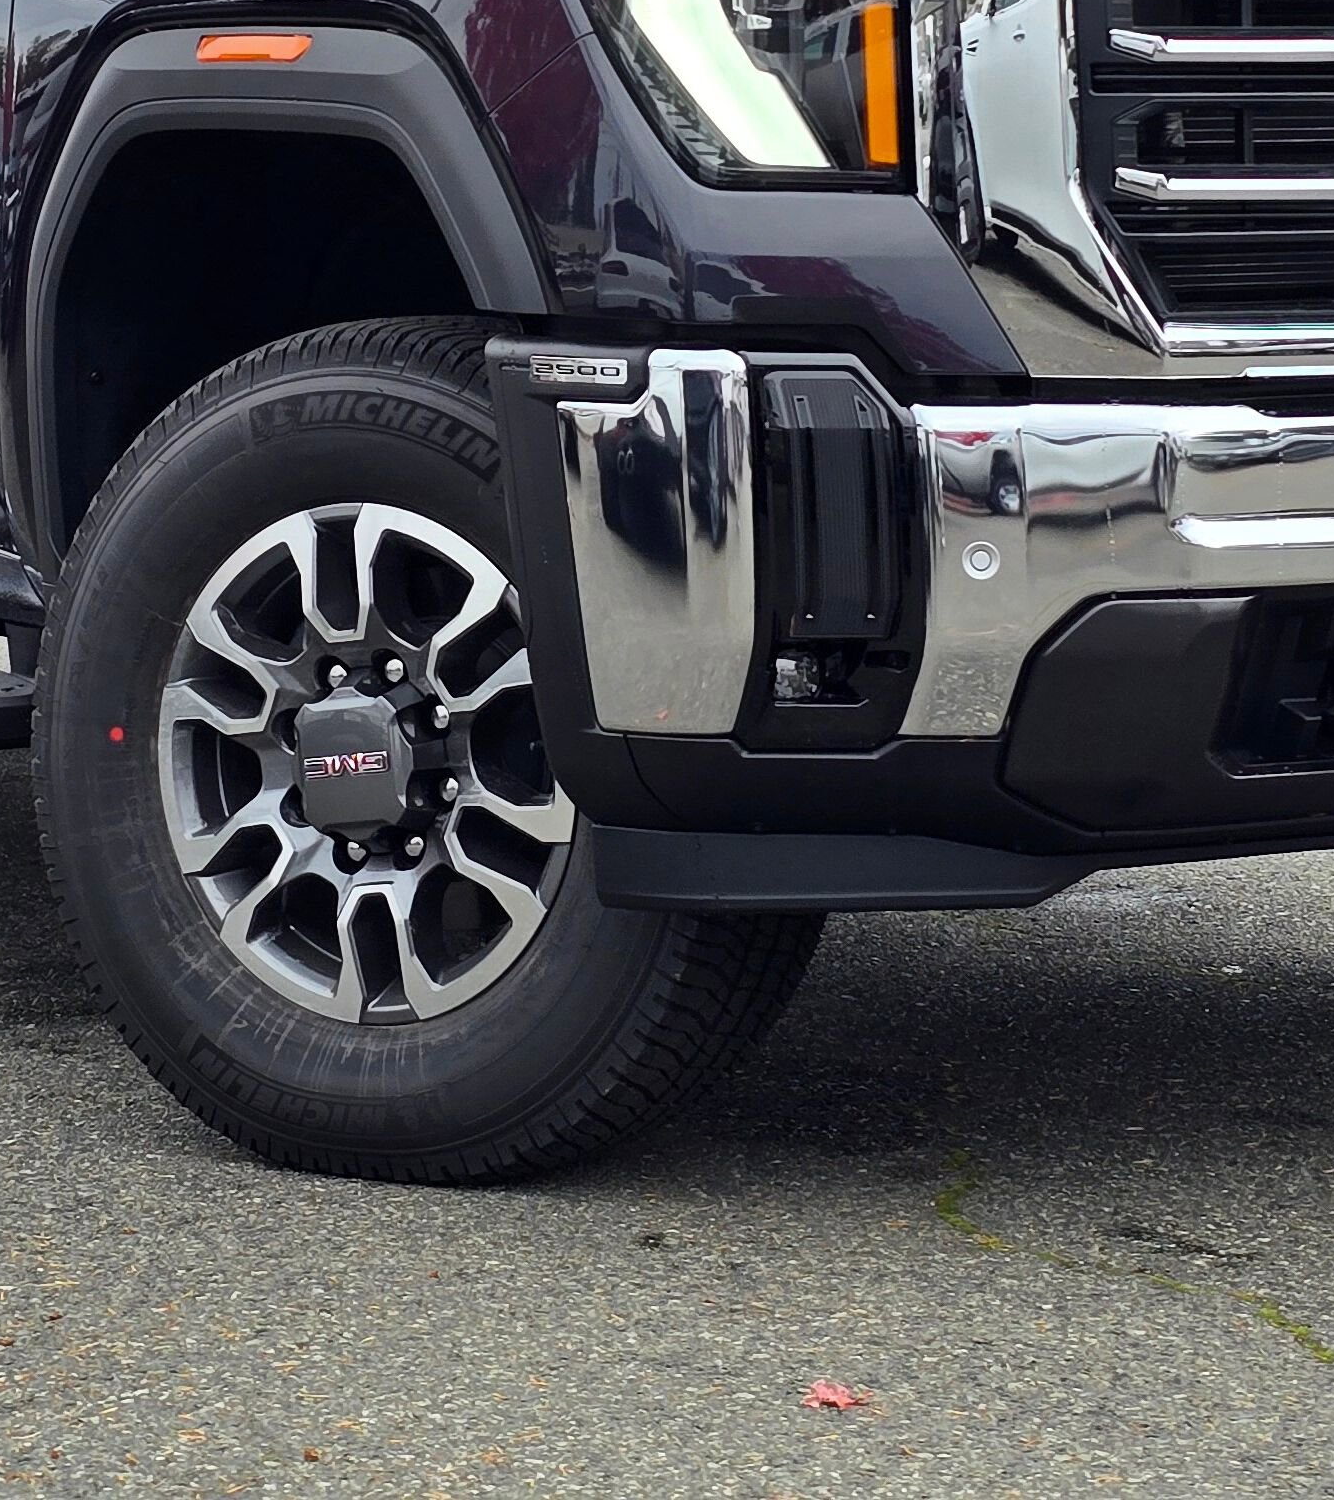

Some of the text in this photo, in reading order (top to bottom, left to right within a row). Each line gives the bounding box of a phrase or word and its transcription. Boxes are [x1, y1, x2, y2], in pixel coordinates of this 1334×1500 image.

[534, 362, 621, 378] 2500
[300, 395, 501, 471] MICHELIN
[303, 750, 389, 780] GMC
